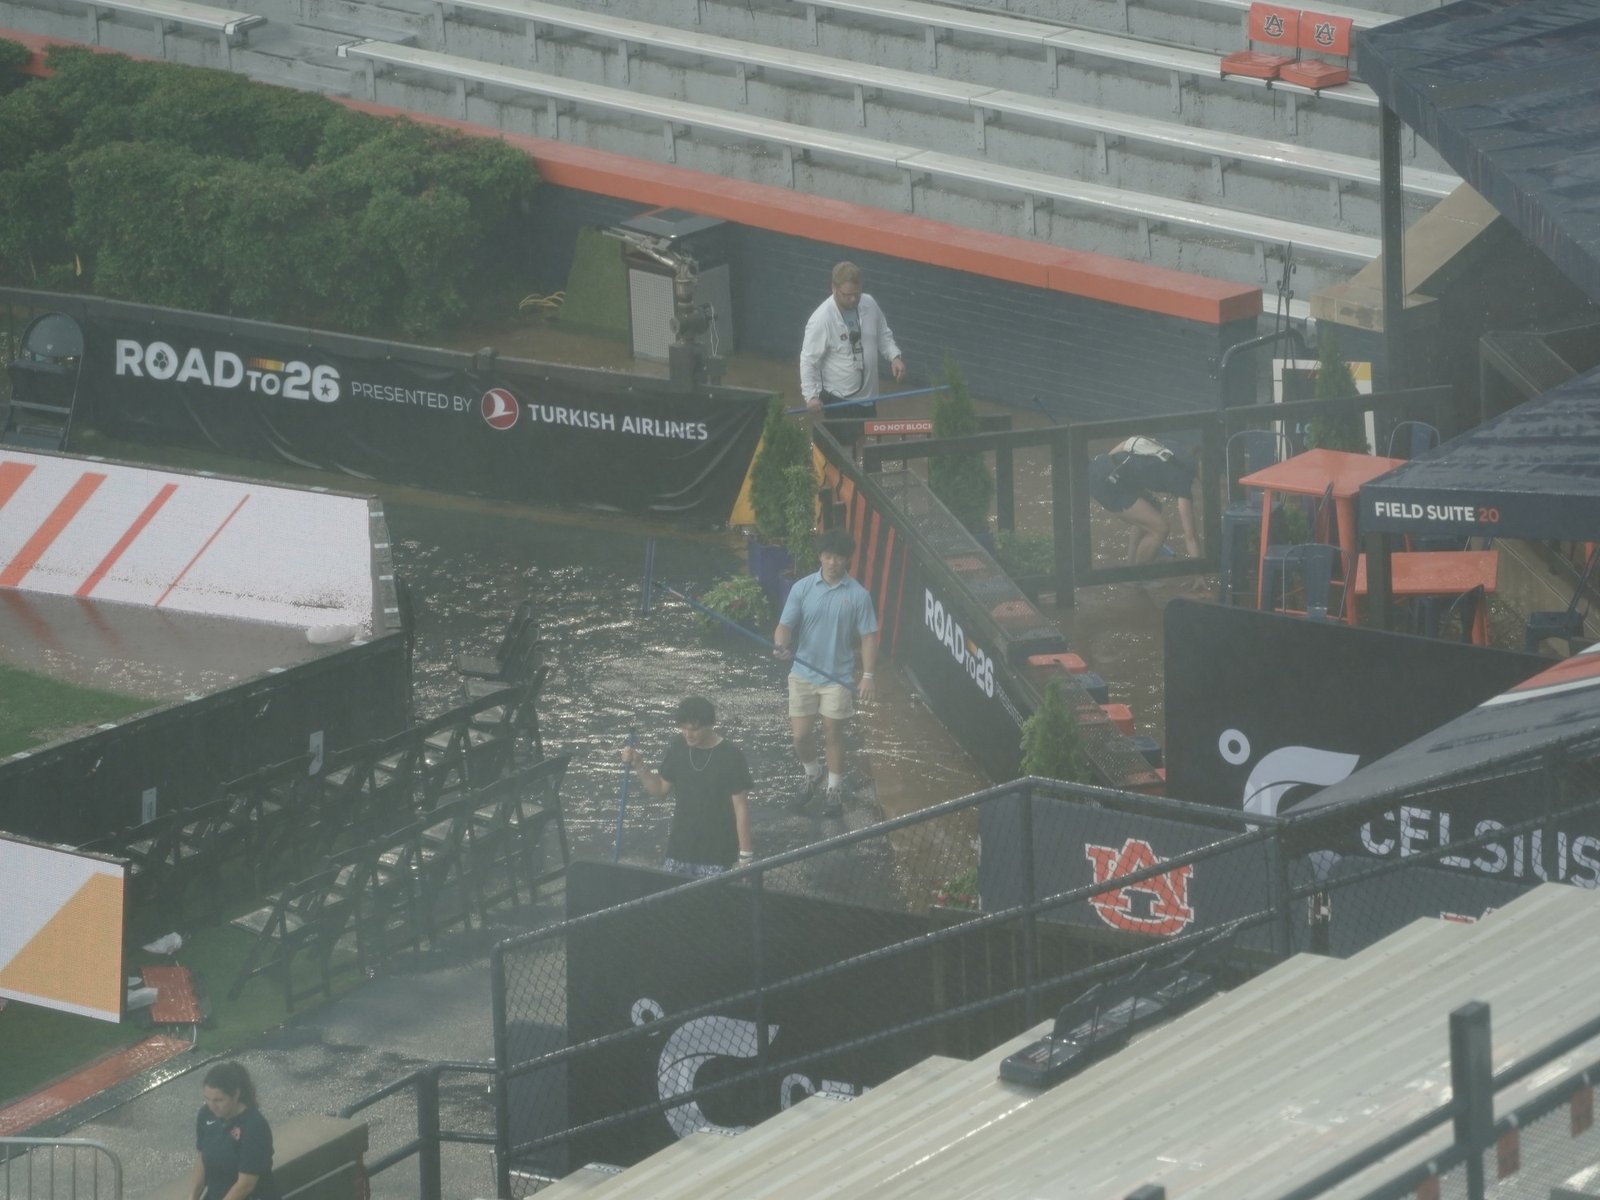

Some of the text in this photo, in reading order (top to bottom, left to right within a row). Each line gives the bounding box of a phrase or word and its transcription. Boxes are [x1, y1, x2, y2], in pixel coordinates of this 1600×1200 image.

[115, 339, 709, 441] ROAD TO 26 PRESENTED BY TURKISH AIRLINES
[873, 423, 887, 432] DO
[887, 423, 905, 432] NOT
[1374, 501, 1500, 523] FIELD SUITE 20
[924, 587, 994, 698] ROAD TO 26
[1360, 804, 1600, 889] CELSIUS
